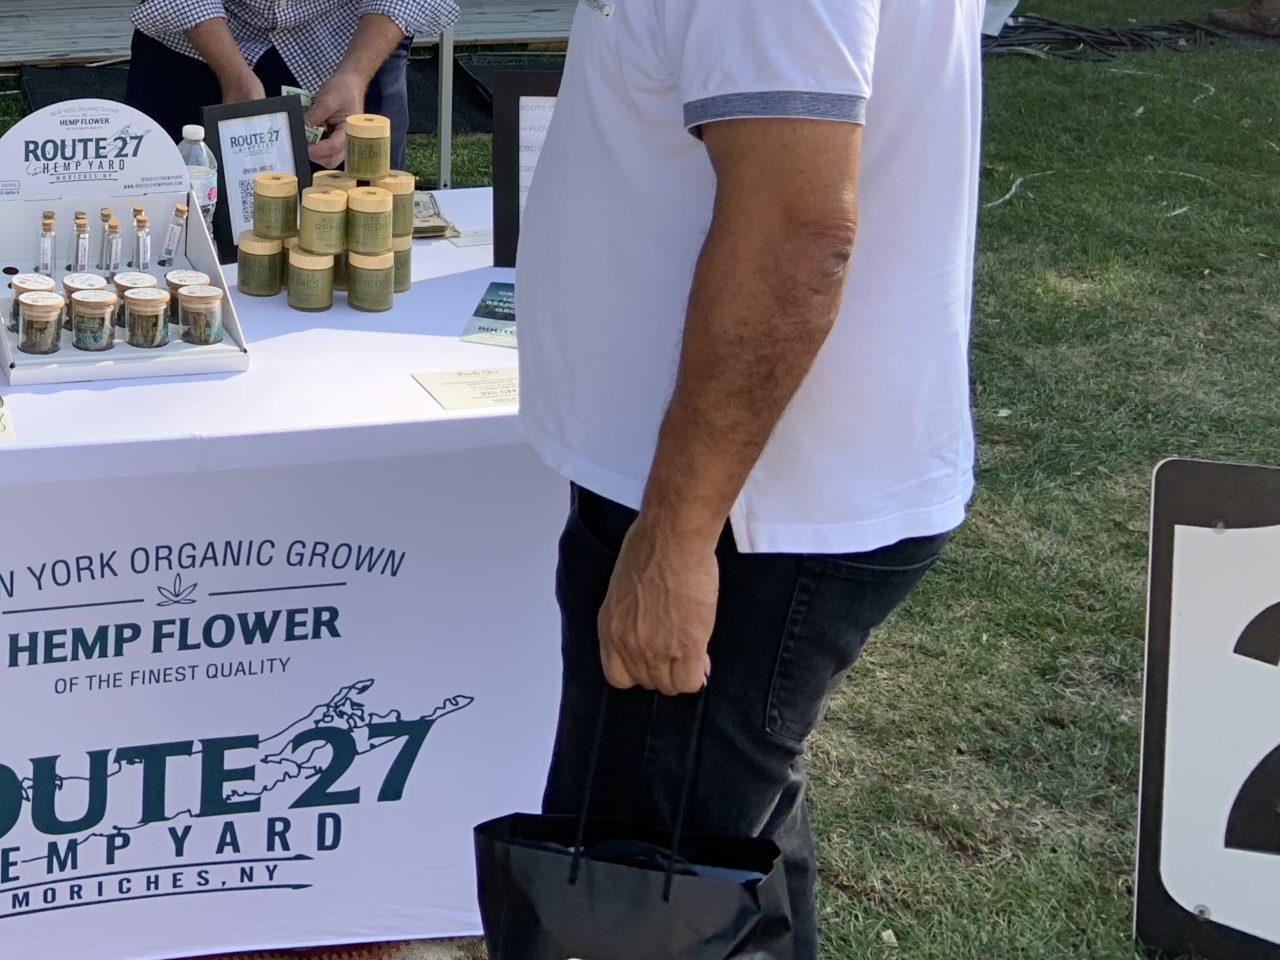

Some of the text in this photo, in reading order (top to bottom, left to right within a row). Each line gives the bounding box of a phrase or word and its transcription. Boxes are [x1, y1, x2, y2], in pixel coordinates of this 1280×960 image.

[59, 117, 110, 126] HEMP FLOWER
[230, 129, 280, 149] ROUTE 27
[24, 134, 145, 162] ROUTE 27
[42, 159, 125, 174] HEMP YARD
[26, 551, 119, 592] YORK
[130, 540, 275, 574] ORGANIC
[286, 540, 406, 577] GROWN
[7, 605, 342, 668] HEMP FLOWER
[54, 657, 291, 694] OF THE FINEST QUALITY
[287, 717, 439, 810] 27
[168, 812, 343, 858] YARD
